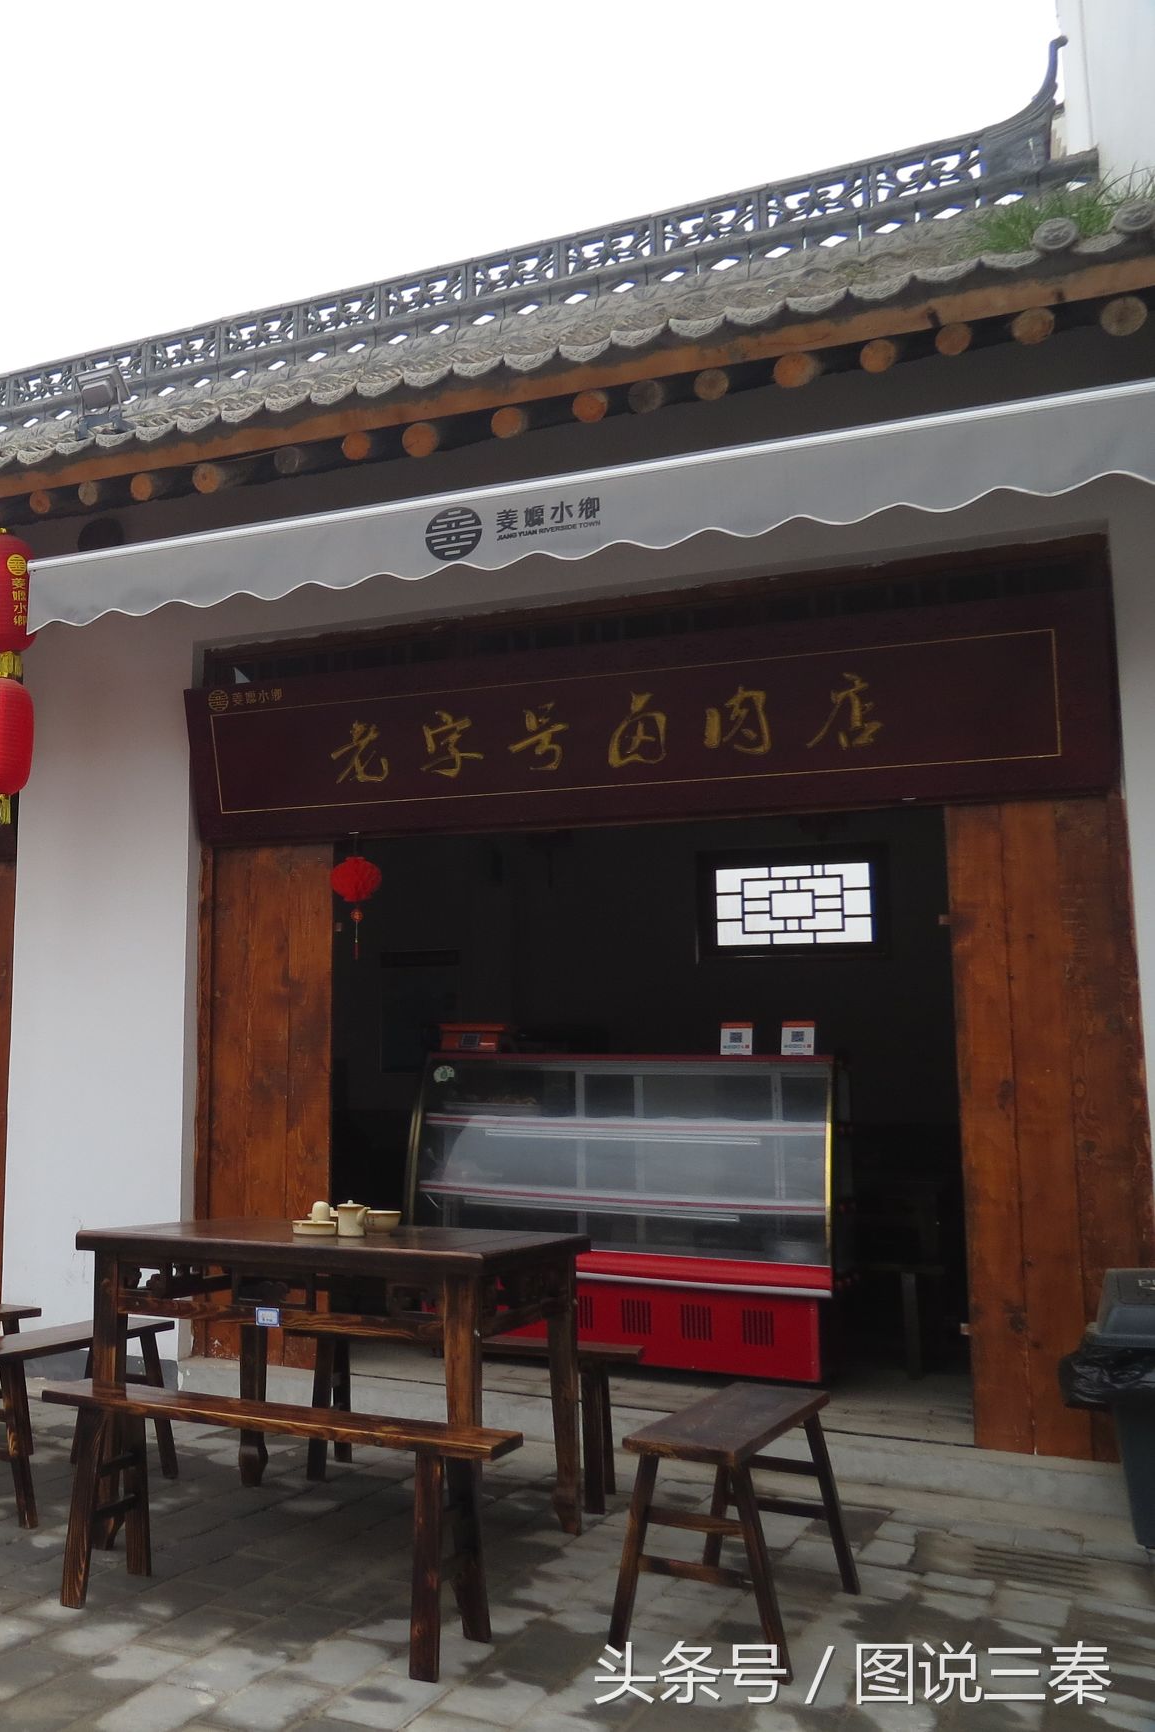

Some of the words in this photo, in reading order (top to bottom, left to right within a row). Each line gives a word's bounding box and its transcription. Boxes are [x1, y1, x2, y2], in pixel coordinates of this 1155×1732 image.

[496, 532, 518, 541] JIANG
[518, 528, 538, 538] YUAN
[538, 523, 577, 534] RIVERSIDE
[579, 519, 601, 529] TOWN
[331, 672, 883, 784] 老字号卤肉店
